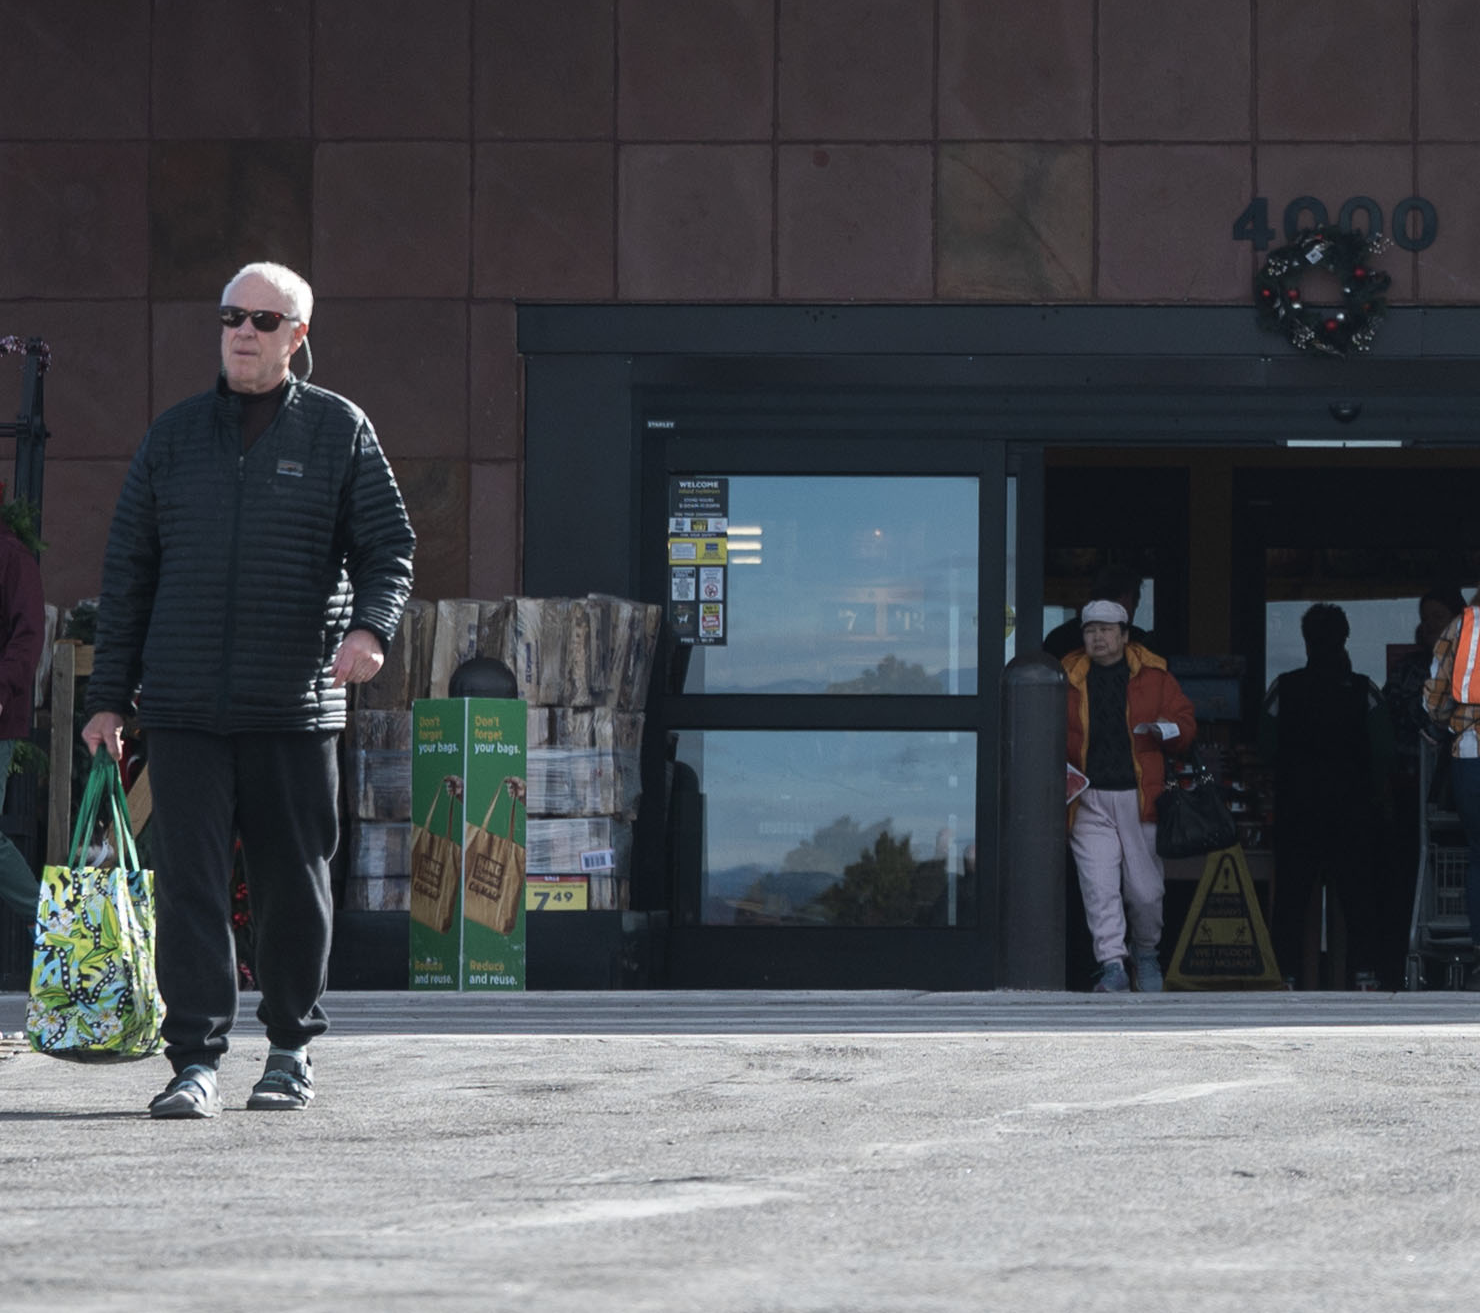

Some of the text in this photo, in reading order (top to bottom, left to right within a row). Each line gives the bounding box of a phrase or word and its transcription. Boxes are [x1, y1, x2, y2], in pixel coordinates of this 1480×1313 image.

[1231, 195, 1439, 252] 4000
[679, 480, 719, 489] WELCOME
[474, 715, 500, 727] Don't
[474, 728, 503, 741] forget
[418, 741, 459, 755] your bags.
[474, 741, 521, 756] your bags.
[470, 959, 505, 972] Reduce
[415, 974, 454, 984] and reuse.
[469, 973, 518, 985] and reuse.
